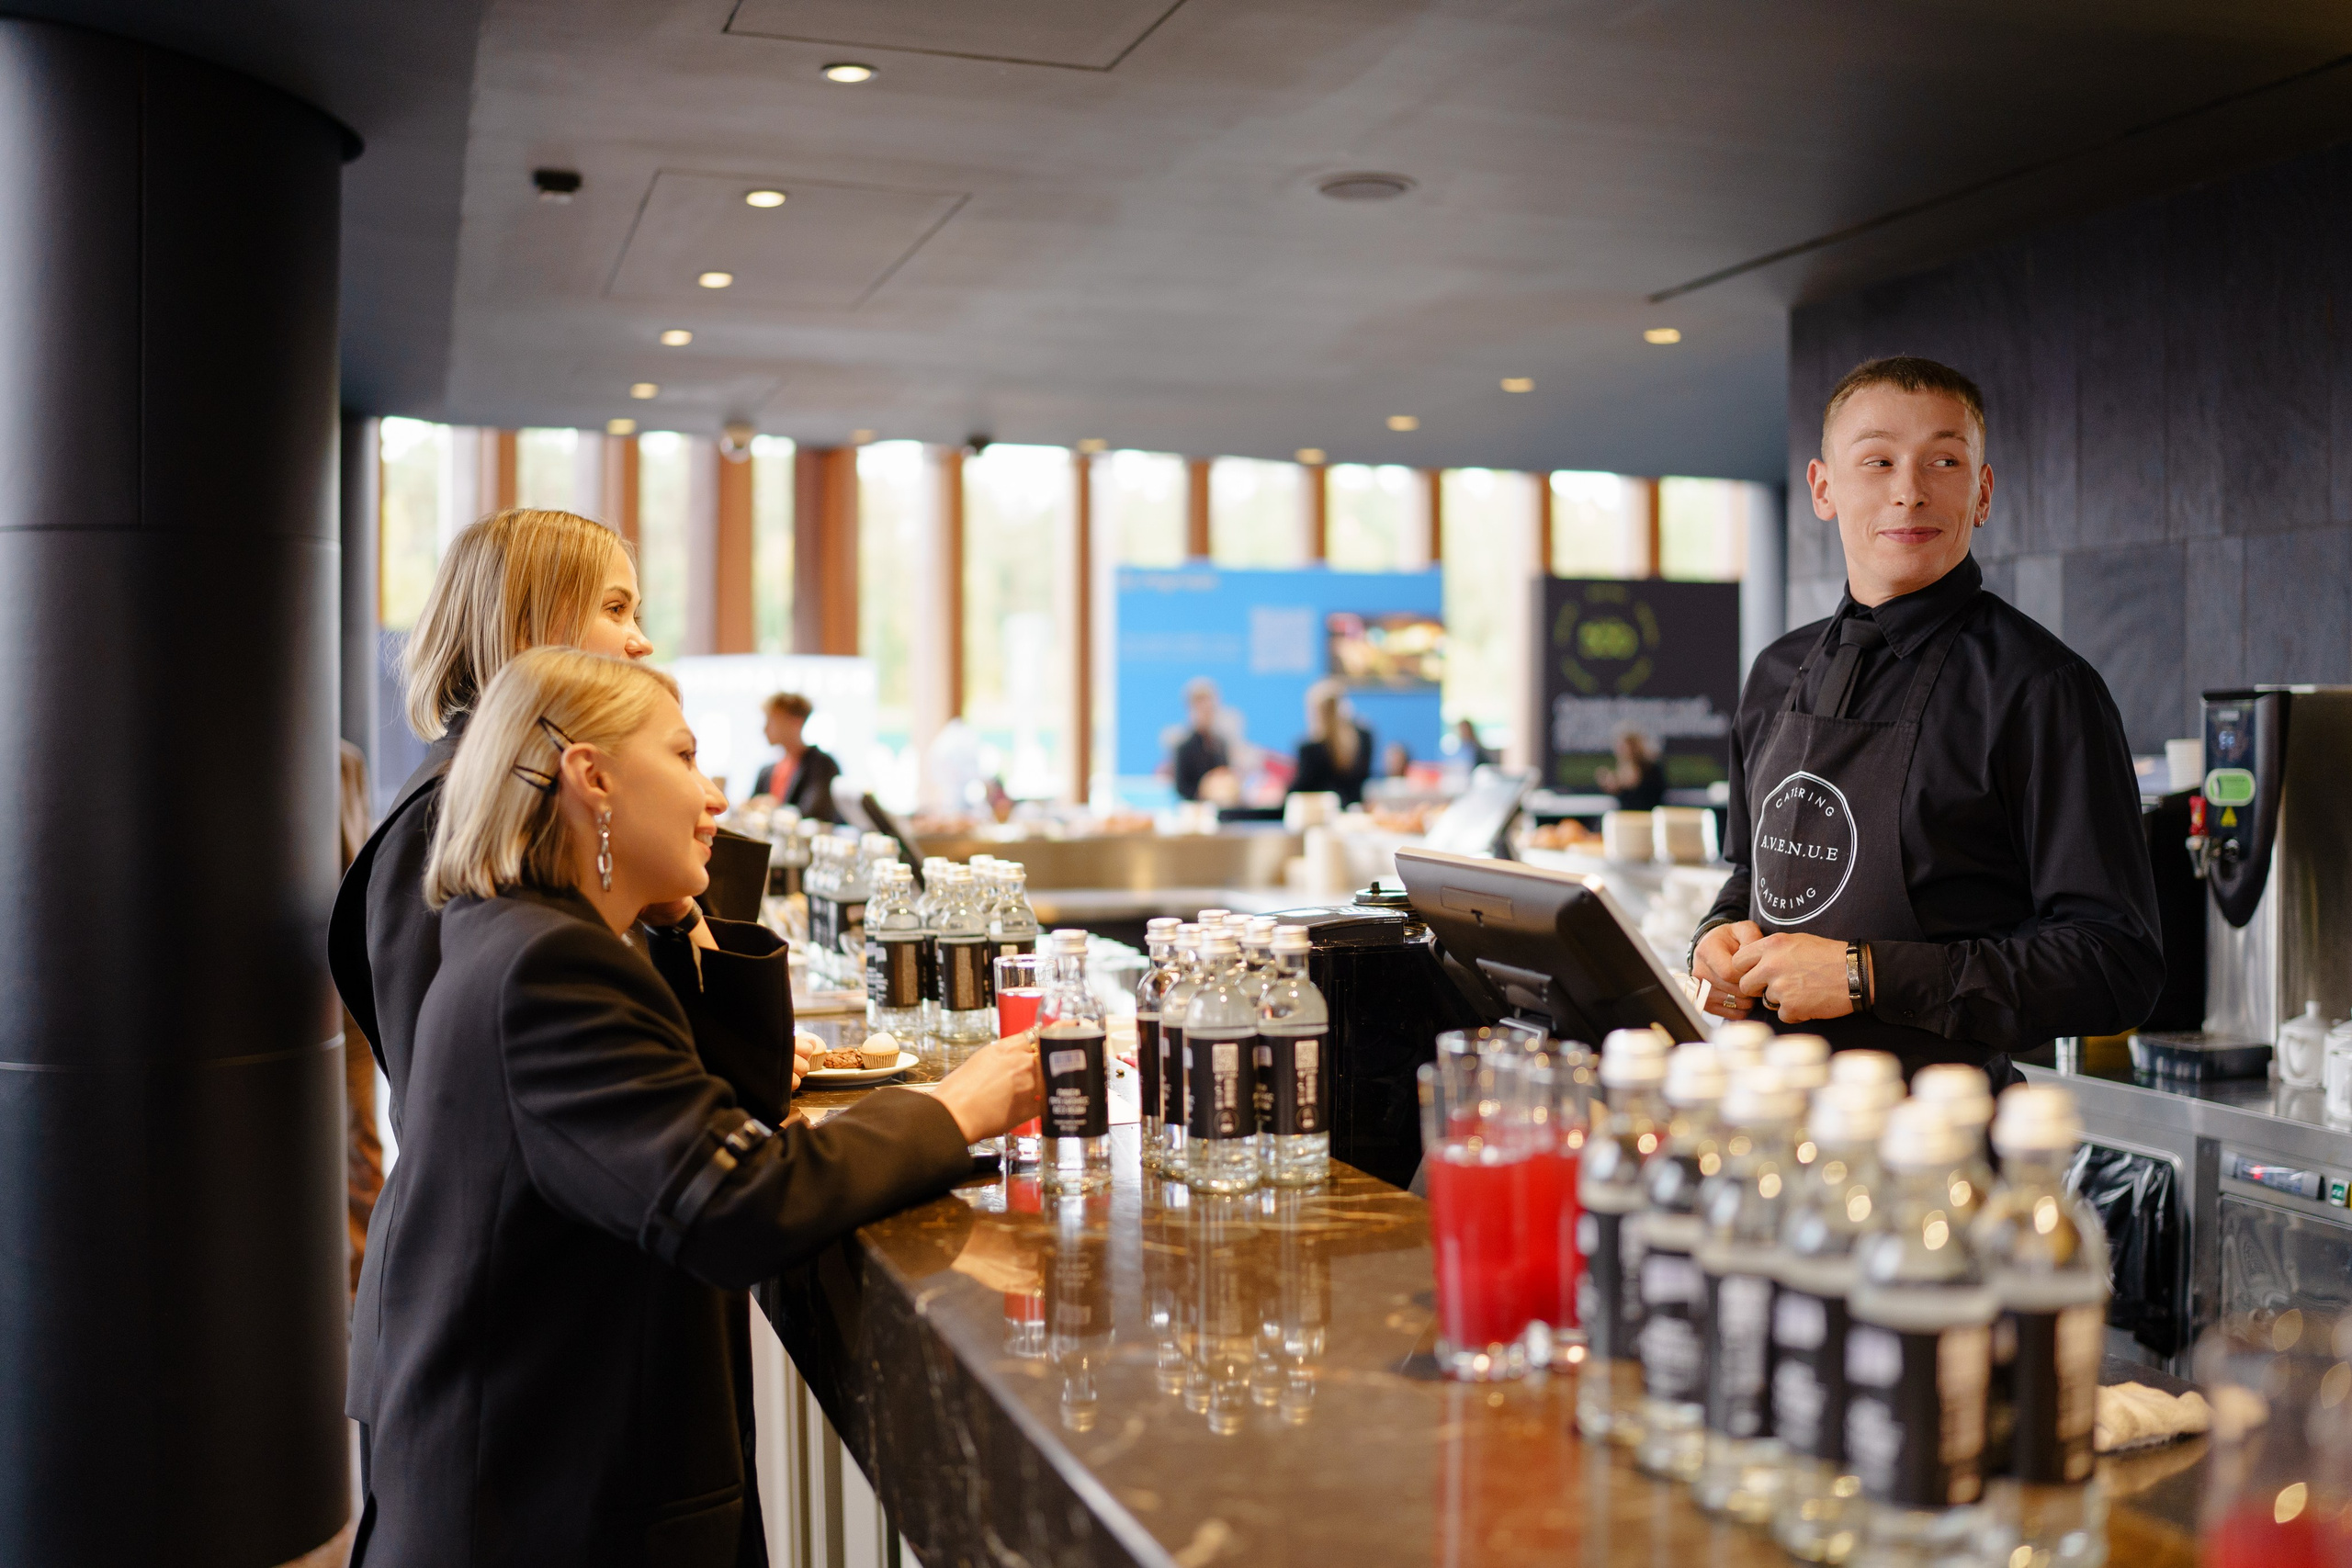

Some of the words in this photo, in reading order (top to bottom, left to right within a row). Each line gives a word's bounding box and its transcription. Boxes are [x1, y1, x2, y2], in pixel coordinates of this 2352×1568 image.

[1775, 787, 1835, 818] CATERING
[1760, 834, 1838, 862] A.V.E.N.U.E
[1760, 876, 1817, 909] CATERING
